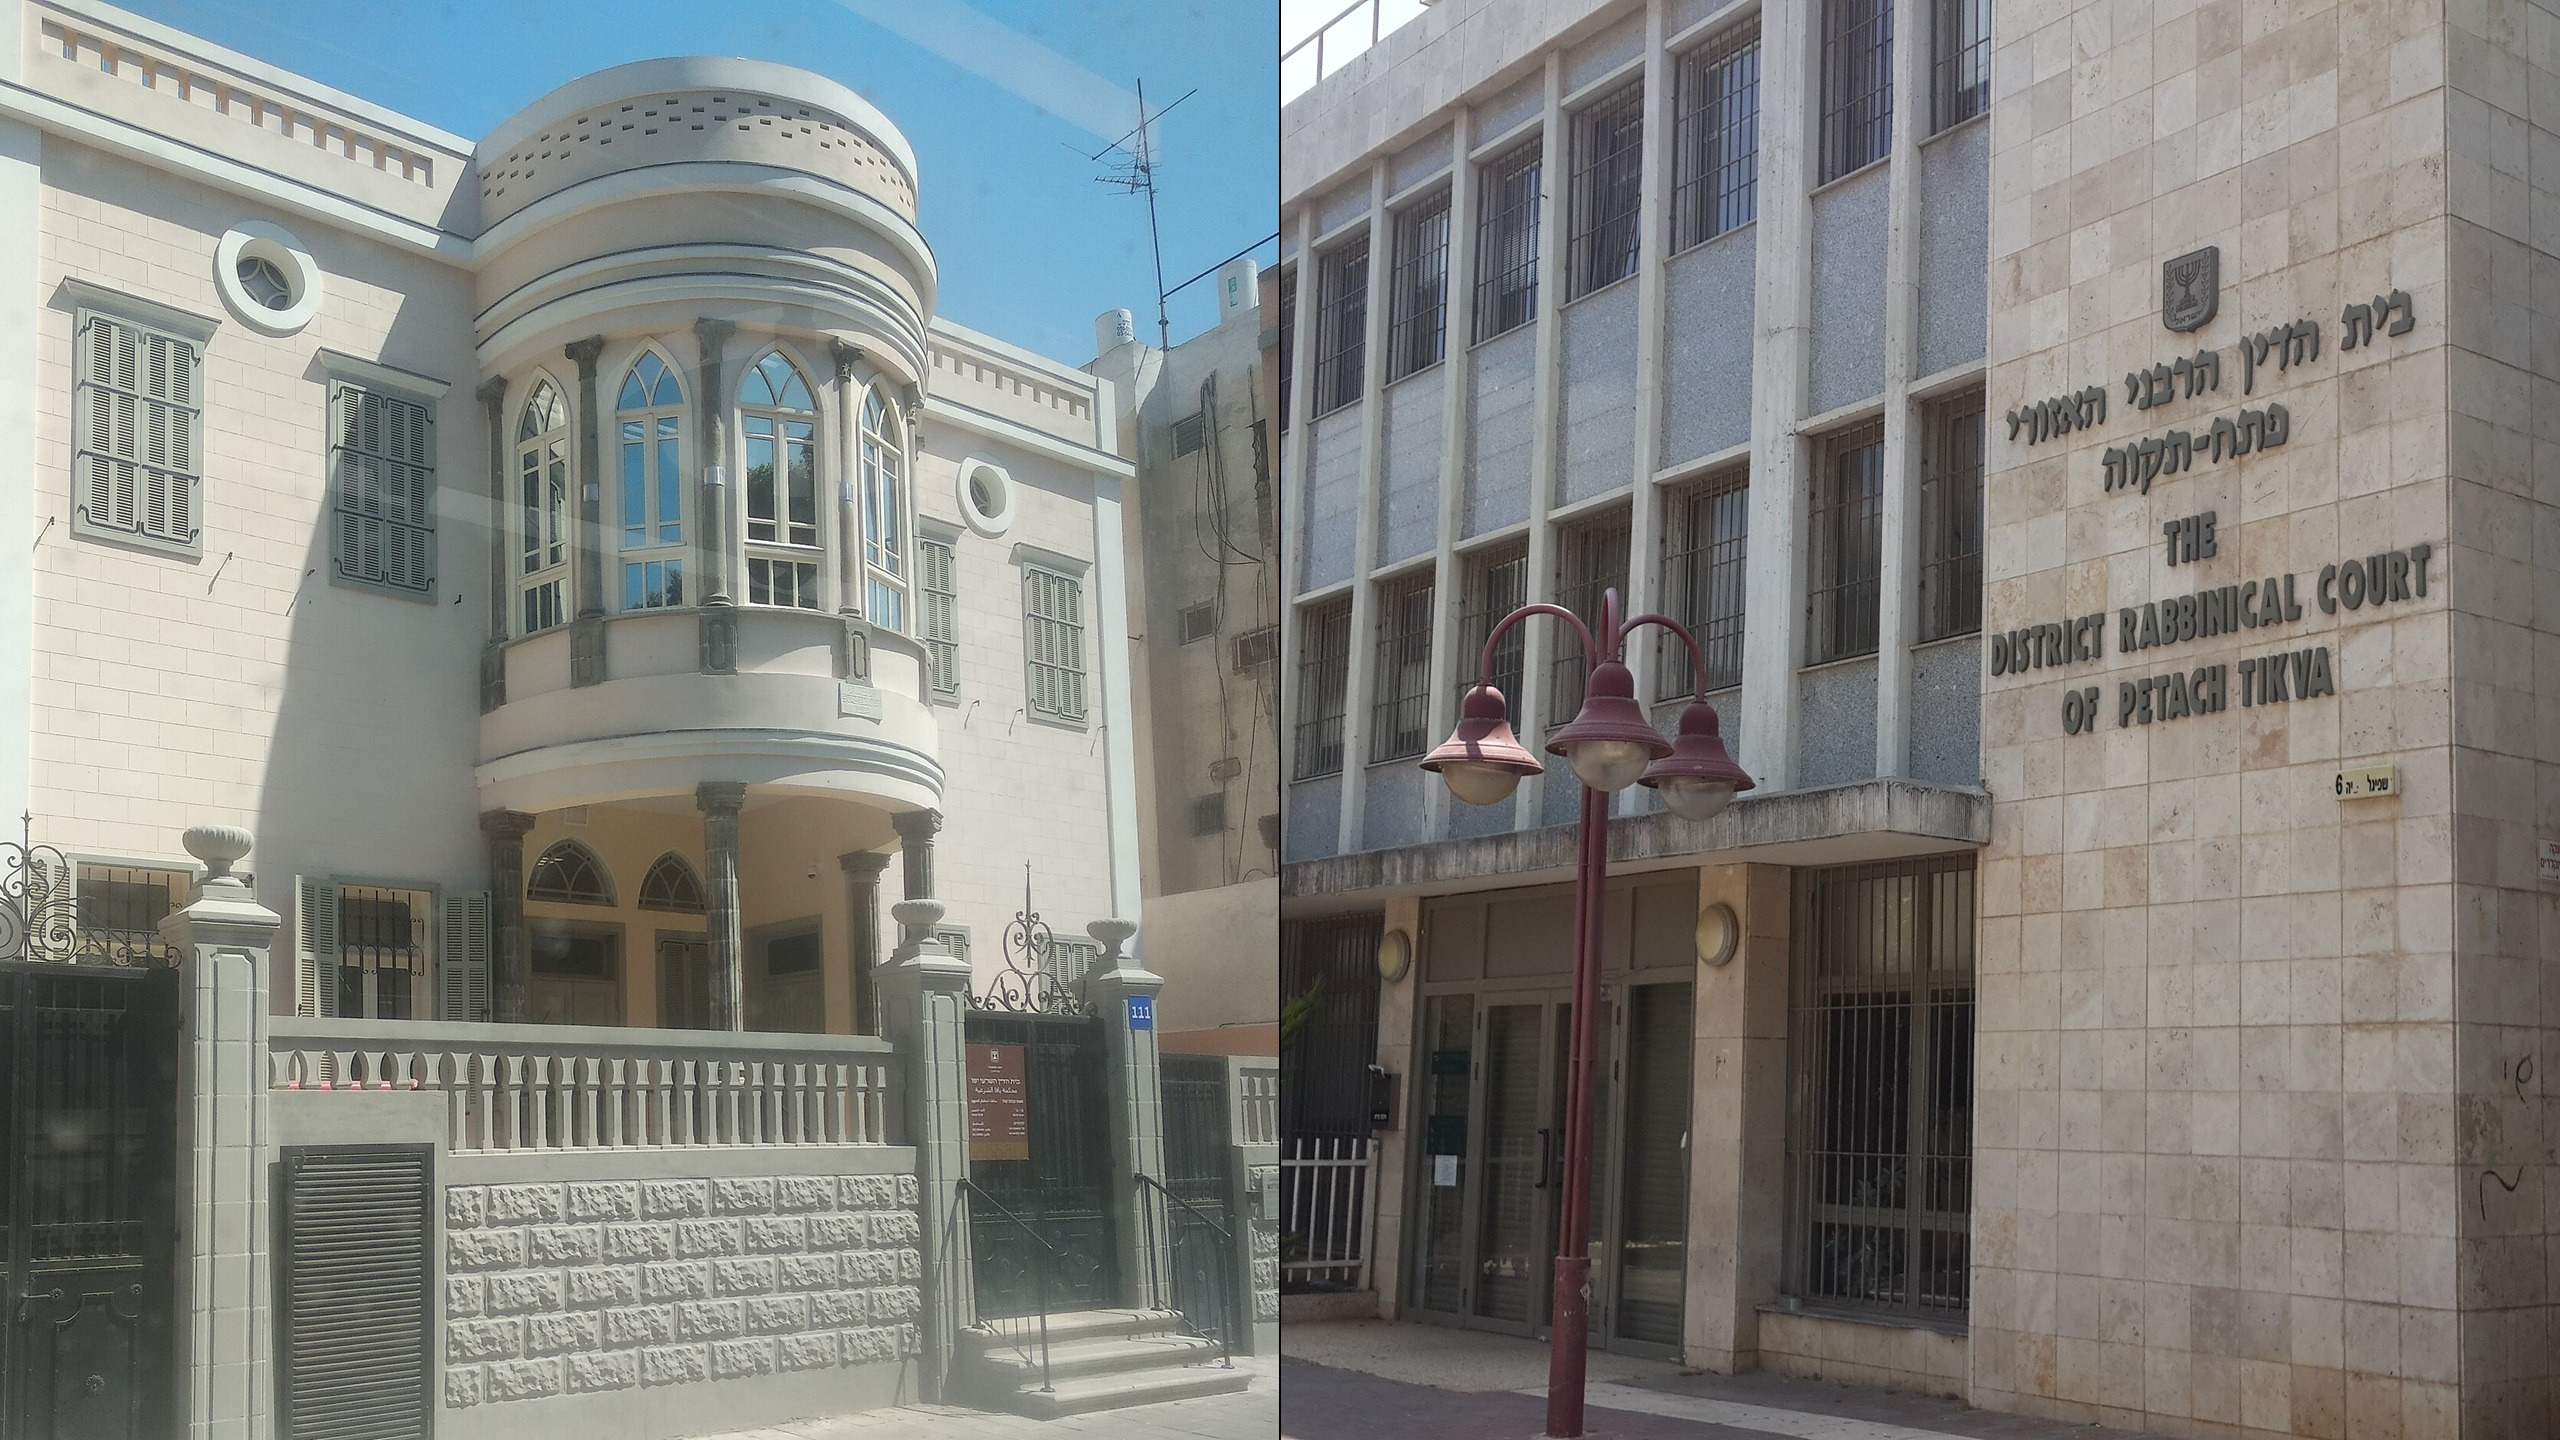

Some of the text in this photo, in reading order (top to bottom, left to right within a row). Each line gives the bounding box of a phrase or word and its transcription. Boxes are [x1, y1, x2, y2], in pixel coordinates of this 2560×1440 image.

[2174, 311, 2201, 325] ישראל
[2005, 288, 2415, 446] בית הדין הרבני האזורי
[2101, 402, 2289, 495] פתח-תקוה
[2163, 511, 2218, 567] THE
[1990, 544, 2431, 677] DISTRICT RABBINICAL COURT
[2061, 646, 2335, 736] OF PETACH TIKVA
[2335, 773, 2343, 796] 6
[1131, 1005, 1151, 1019] 111
